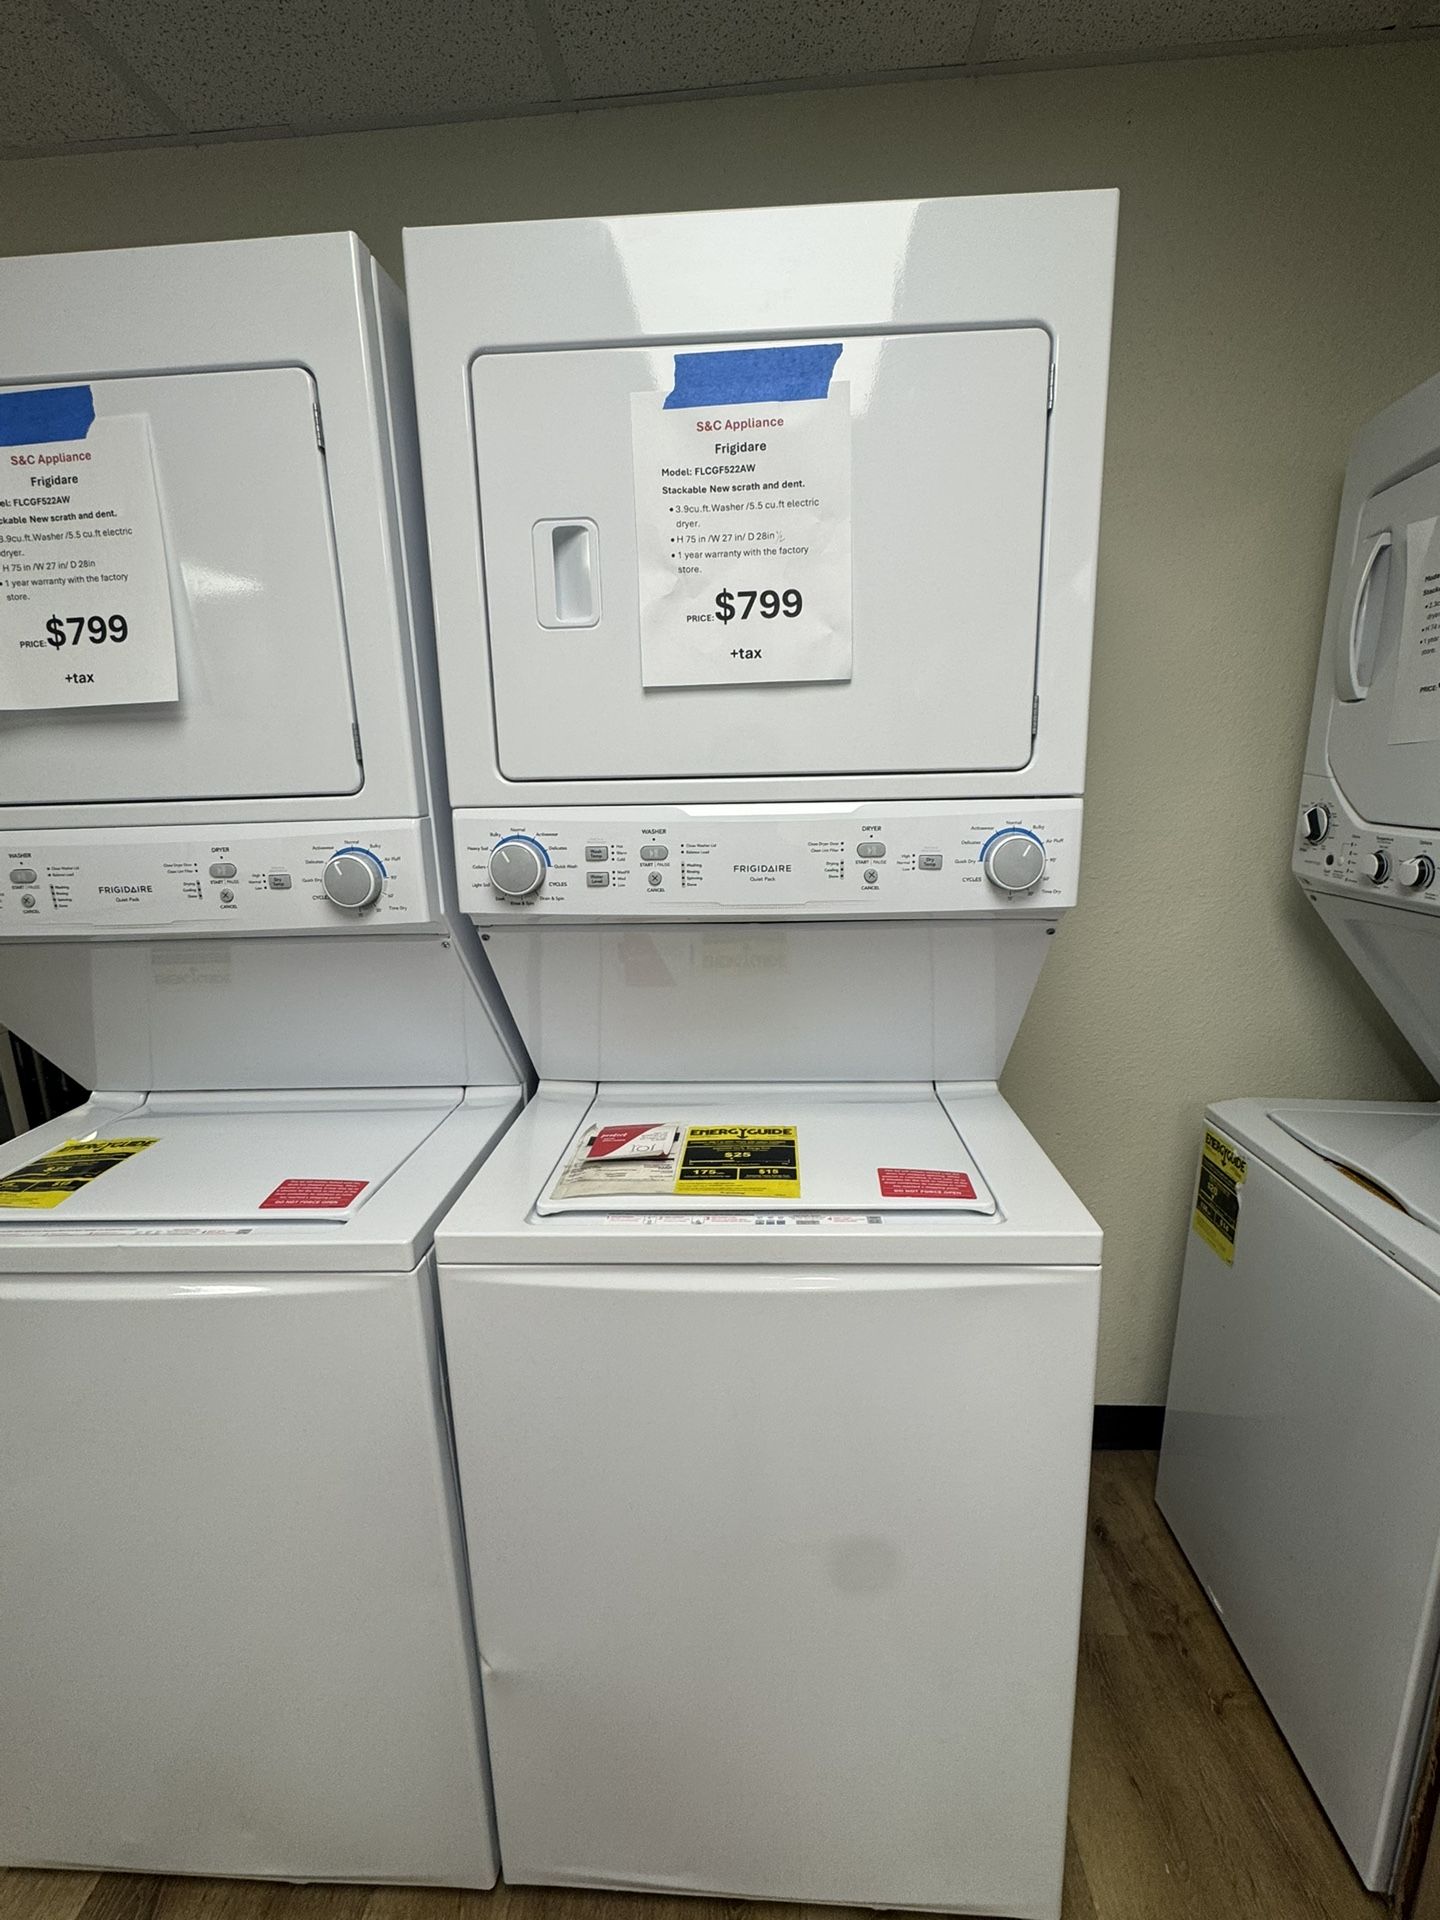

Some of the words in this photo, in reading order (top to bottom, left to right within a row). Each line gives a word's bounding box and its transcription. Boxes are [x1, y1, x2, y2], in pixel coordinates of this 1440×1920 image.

[696, 420, 722, 432] S&C
[725, 415, 784, 432] Appliance
[714, 441, 767, 456] Frigidare
[10, 455, 35, 466] S&C
[37, 451, 92, 466] Appliance
[661, 467, 692, 477] Model:
[694, 464, 756, 476] FLCGF522AW
[30, 475, 79, 488] Frigidare
[661, 484, 707, 496] Stackable
[709, 484, 730, 494] New
[731, 480, 760, 493] scrath
[762, 480, 779, 490] and
[781, 479, 806, 490] dent.
[13, 495, 71, 507] FLCGF522AW
[745, 501, 763, 511] /5.5
[764, 499, 785, 510] cu.ft
[787, 498, 819, 508] electric
[29, 514, 49, 524] New
[50, 512, 77, 522] scrath
[78, 511, 94, 520] and
[95, 509, 118, 519] dent.
[676, 518, 700, 529] dryer.
[102, 527, 133, 537] electric
[677, 535, 684, 543] H
[685, 535, 696, 543] 75
[698, 534, 706, 543] in
[708, 533, 721, 543] /W
[722, 533, 733, 542] 27
[734, 532, 746, 543] in/
[748, 532, 755, 541] D
[756, 531, 775, 541] 28in
[0, 549, 25, 560] dryer.
[678, 551, 683, 560] 1
[685, 551, 703, 562] year
[704, 550, 742, 562] warranty
[743, 547, 761, 557] with
[763, 546, 777, 556] the
[779, 545, 809, 557] factory
[2, 563, 10, 572] H
[11, 563, 22, 572] 75
[23, 563, 31, 571] in
[33, 562, 45, 571] /W
[46, 561, 56, 571] 27
[58, 561, 69, 569] in/
[70, 560, 77, 569] D
[78, 560, 96, 569] 28in
[677, 564, 702, 574] store.
[5, 579, 10, 588] 1
[11, 579, 29, 588] year
[31, 577, 66, 587] warranty
[67, 575, 85, 585] with
[86, 574, 99, 583] the
[101, 573, 129, 583] factory
[6, 592, 31, 602] store.
[686, 614, 714, 623] PRICE:
[714, 588, 803, 625] $799
[19, 640, 47, 649] PRICE:
[46, 614, 129, 651] $799
[730, 647, 762, 660] +tax
[65, 672, 95, 684] +tax
[733, 864, 792, 873] FRIGIDAIRE
[98, 886, 153, 894] FRIGIDAIRE
